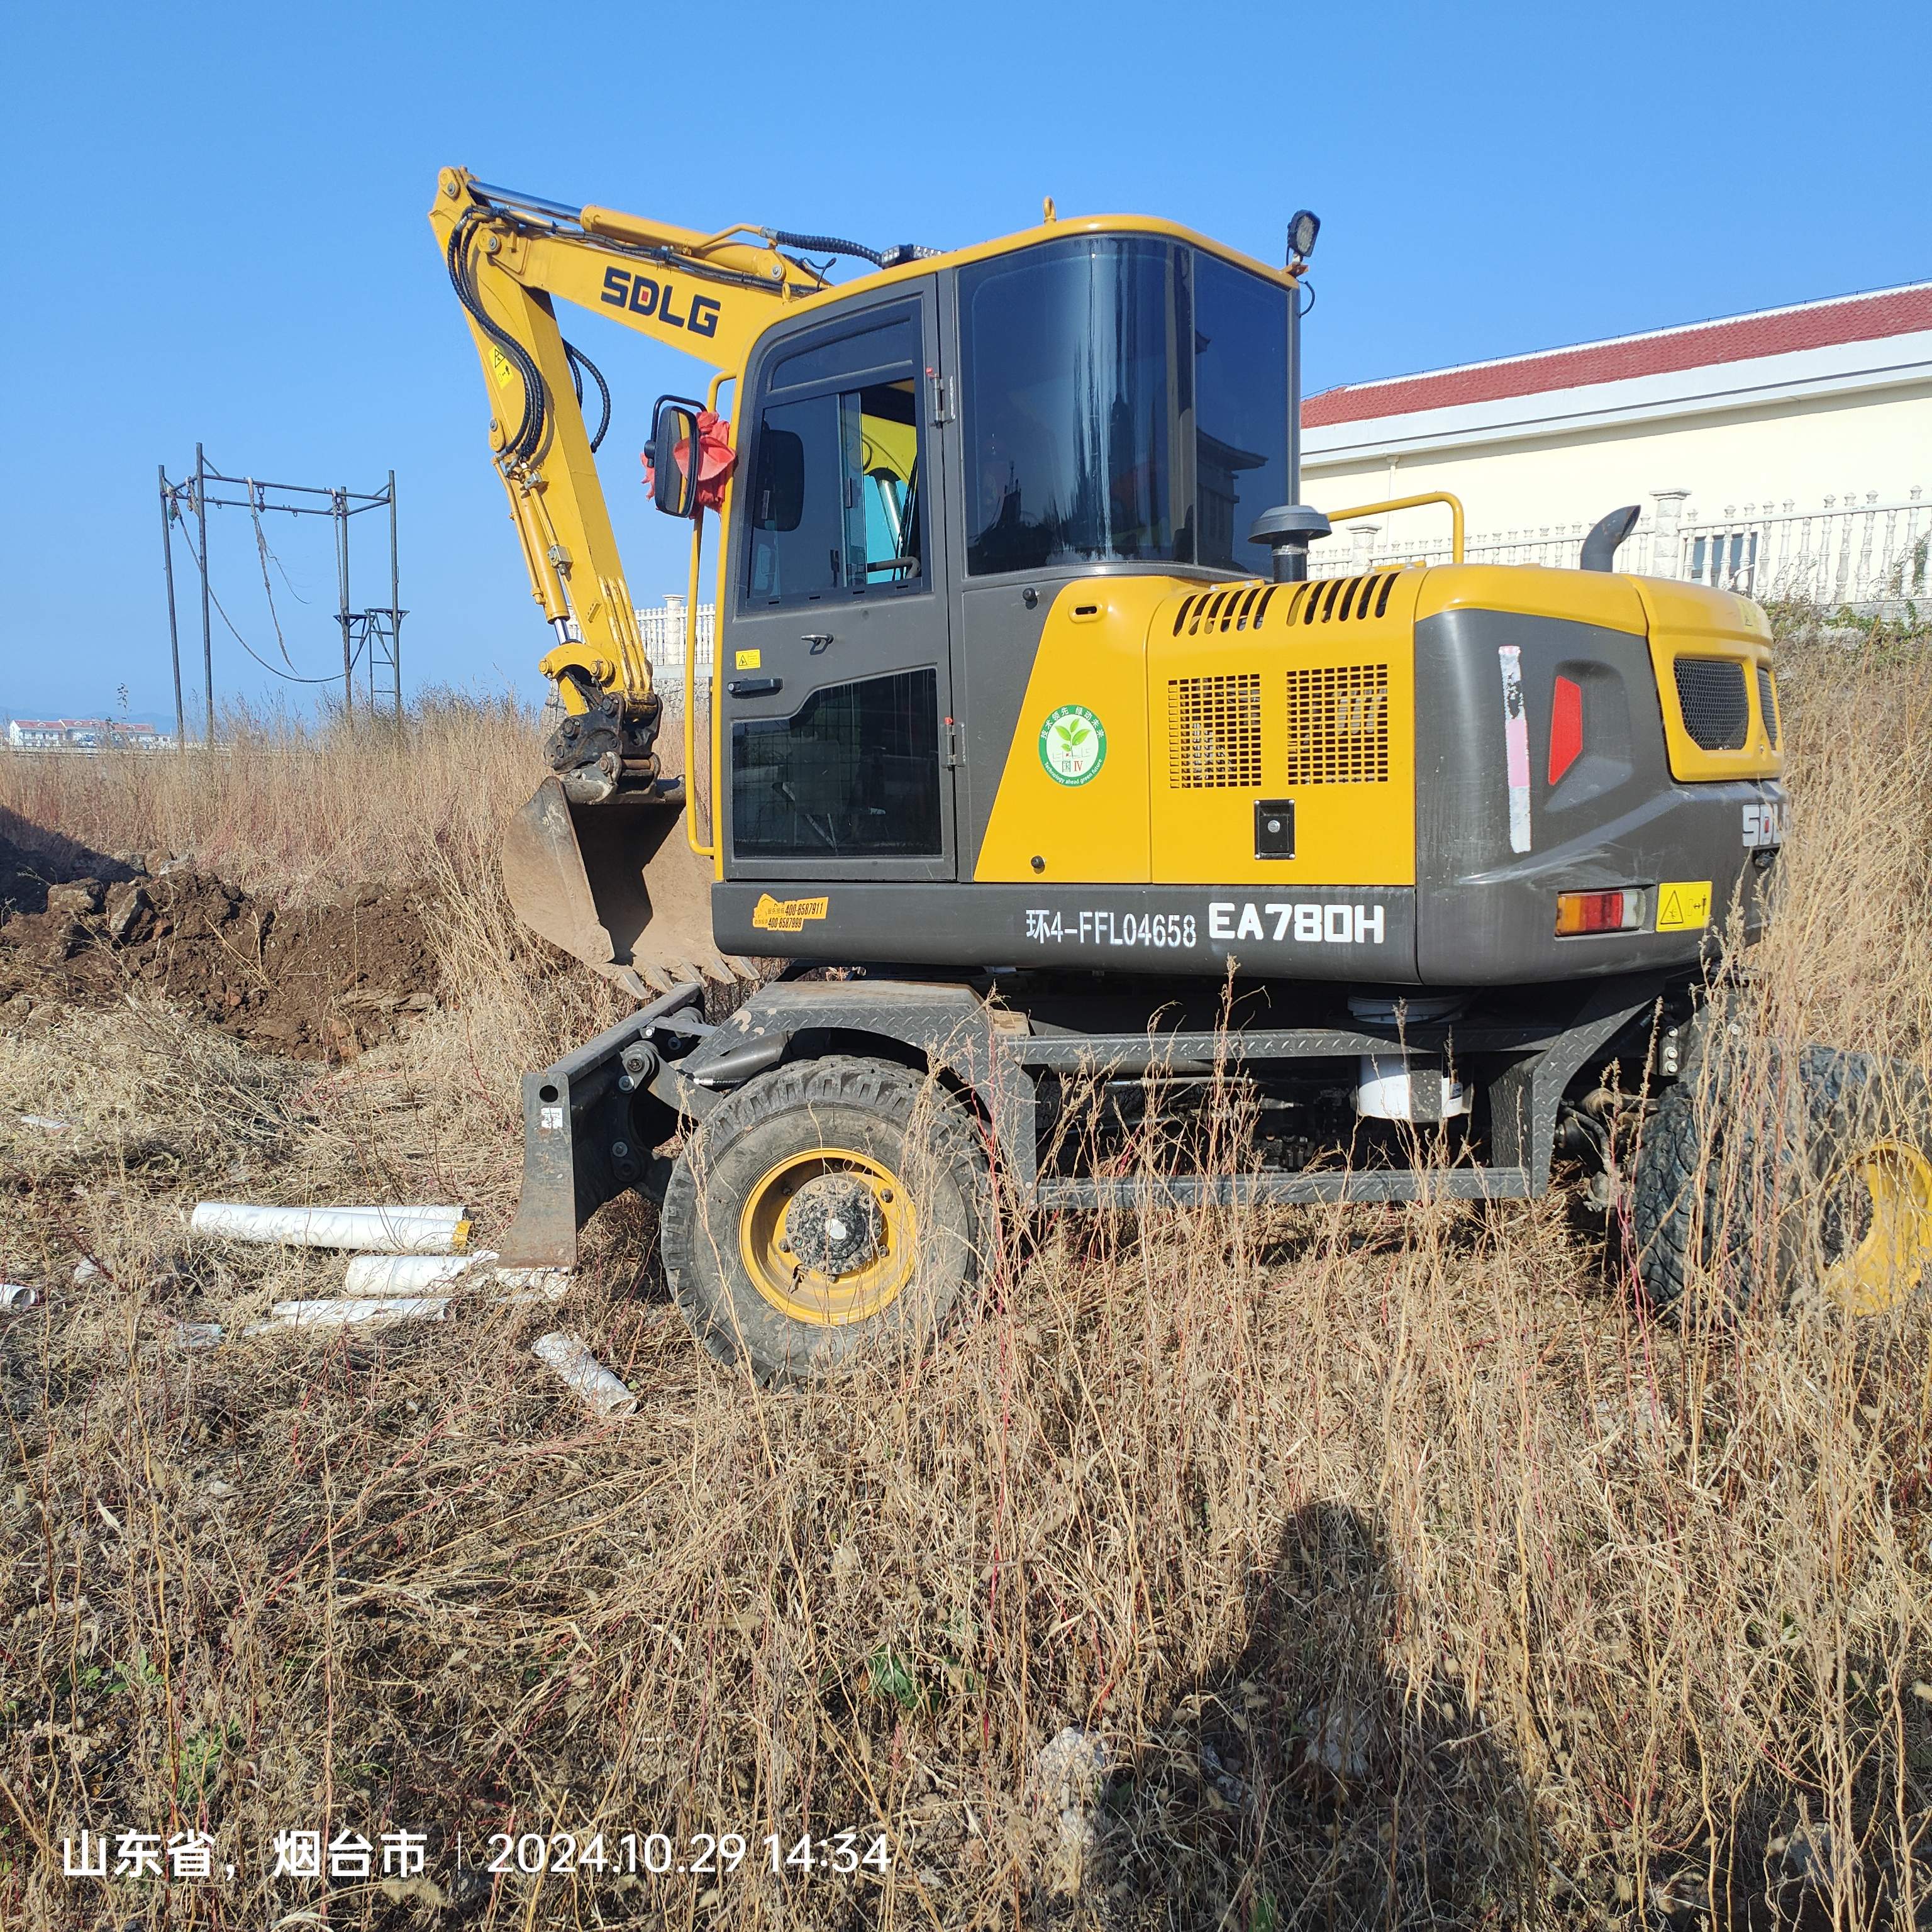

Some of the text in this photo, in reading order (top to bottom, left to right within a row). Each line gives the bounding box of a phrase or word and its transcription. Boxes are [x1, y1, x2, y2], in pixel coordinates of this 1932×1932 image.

[601, 265, 721, 338] SDLG
[785, 902, 824, 917] 400-6587911
[1209, 902, 1384, 944] EA780H
